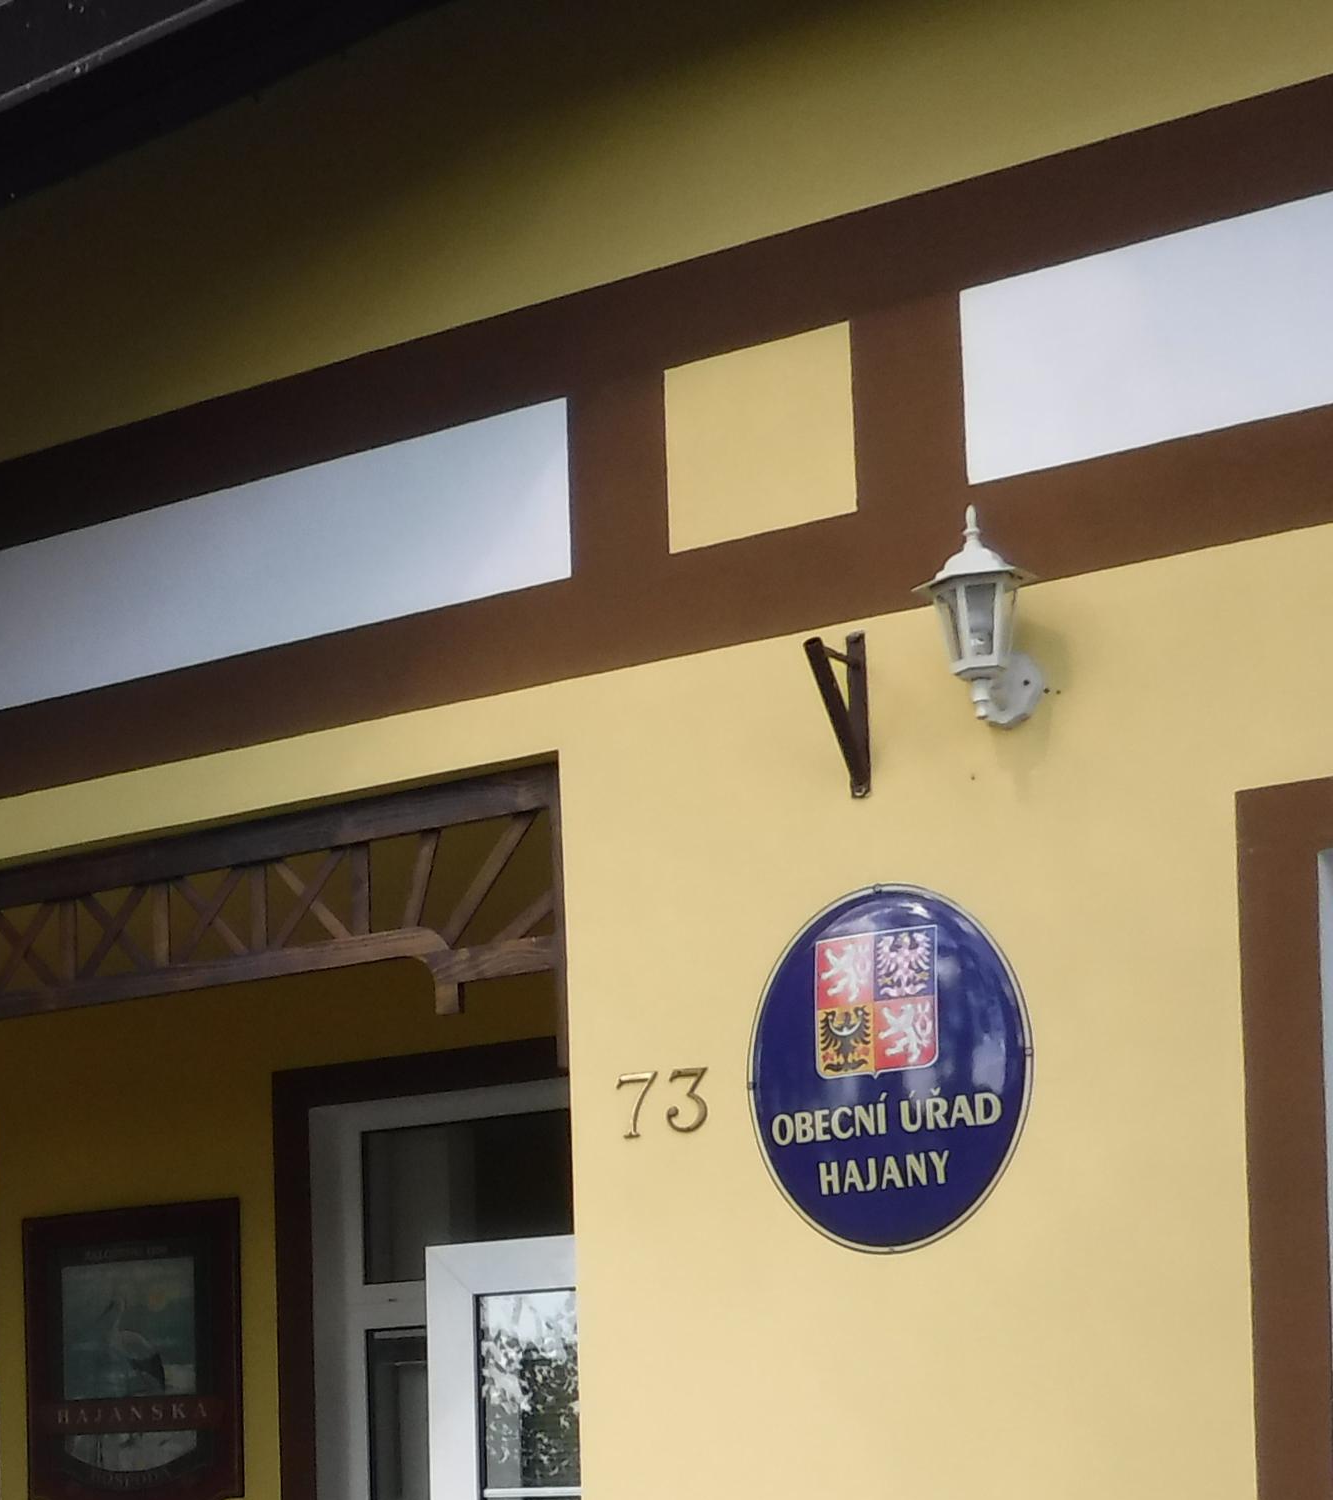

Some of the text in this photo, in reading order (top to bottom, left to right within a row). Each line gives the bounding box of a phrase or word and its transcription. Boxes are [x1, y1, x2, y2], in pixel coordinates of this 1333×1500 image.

[616, 1066, 709, 1140] 73
[771, 1087, 1003, 1146] OBECNÍ ÚŘAD
[818, 1150, 950, 1196] HAJANY
